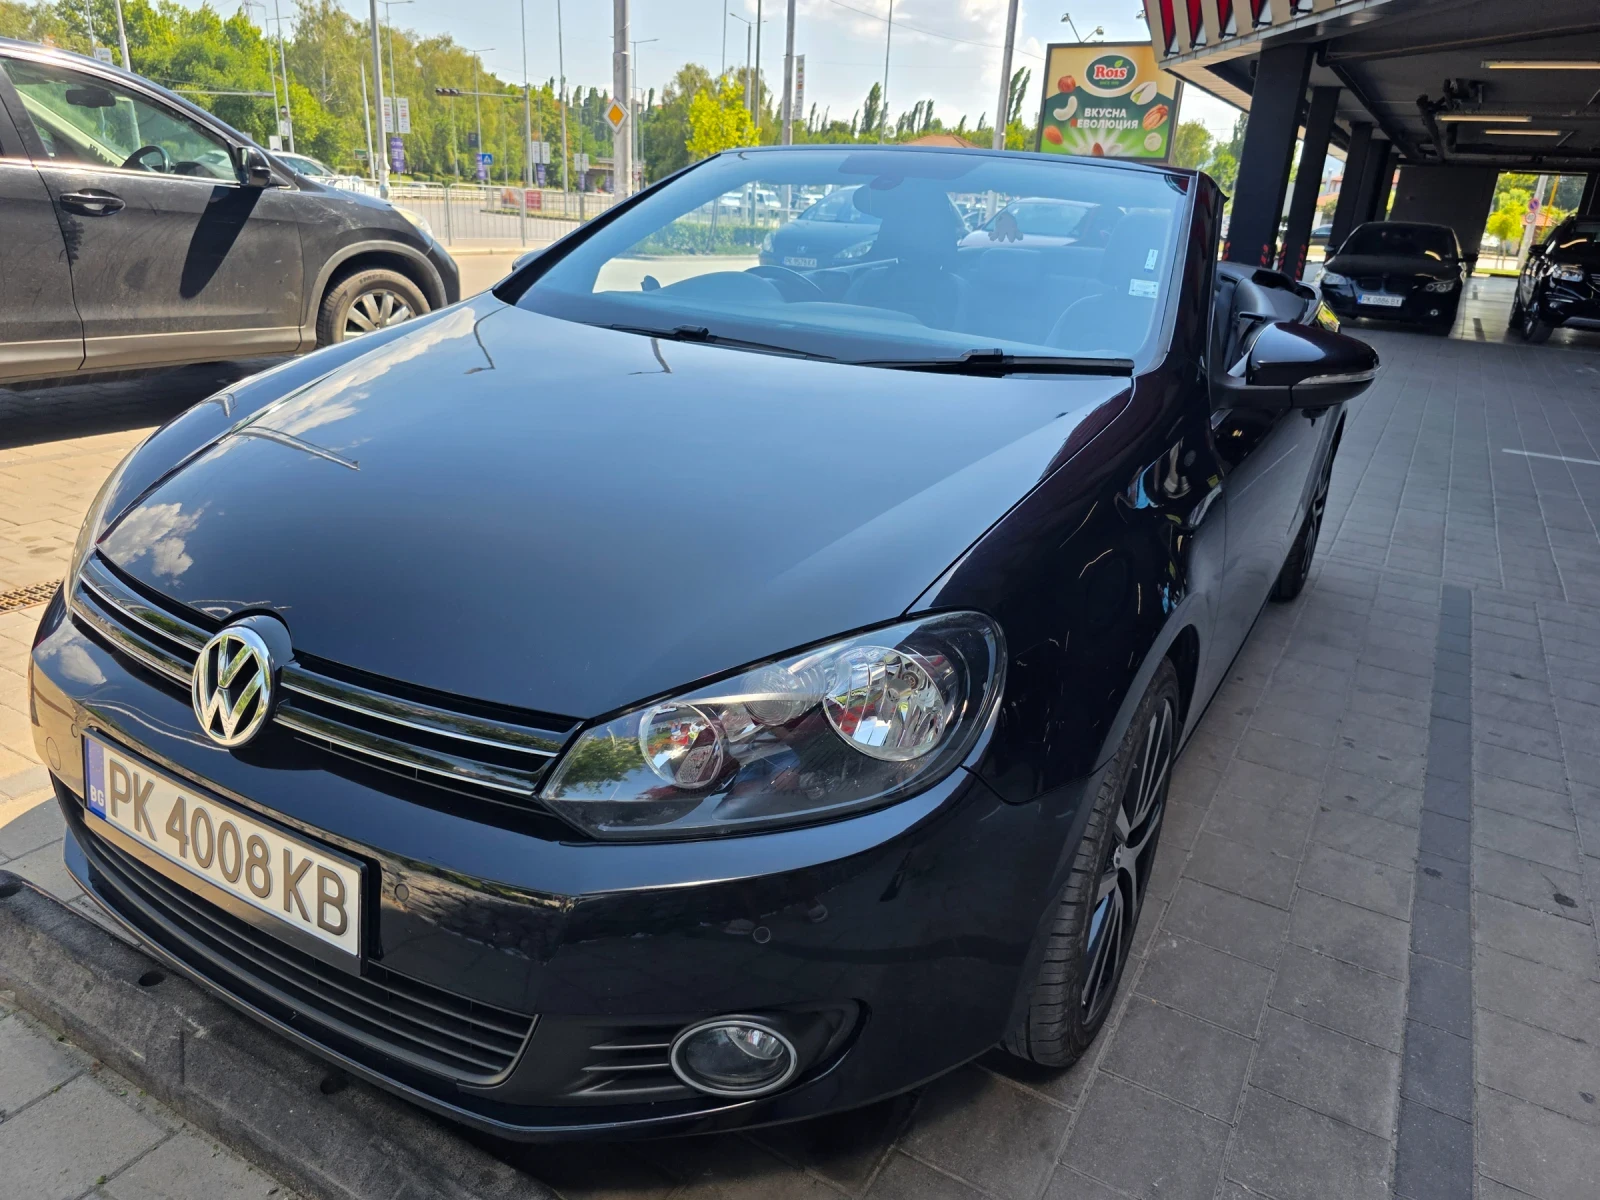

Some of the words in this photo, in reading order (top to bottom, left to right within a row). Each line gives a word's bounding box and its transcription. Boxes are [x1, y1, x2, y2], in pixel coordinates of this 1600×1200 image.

[1084, 107, 1127, 118] ВКУСНА
[90, 784, 105, 807] BG
[109, 757, 158, 843] PK
[165, 796, 274, 900] 4008
[283, 848, 348, 937] KB
